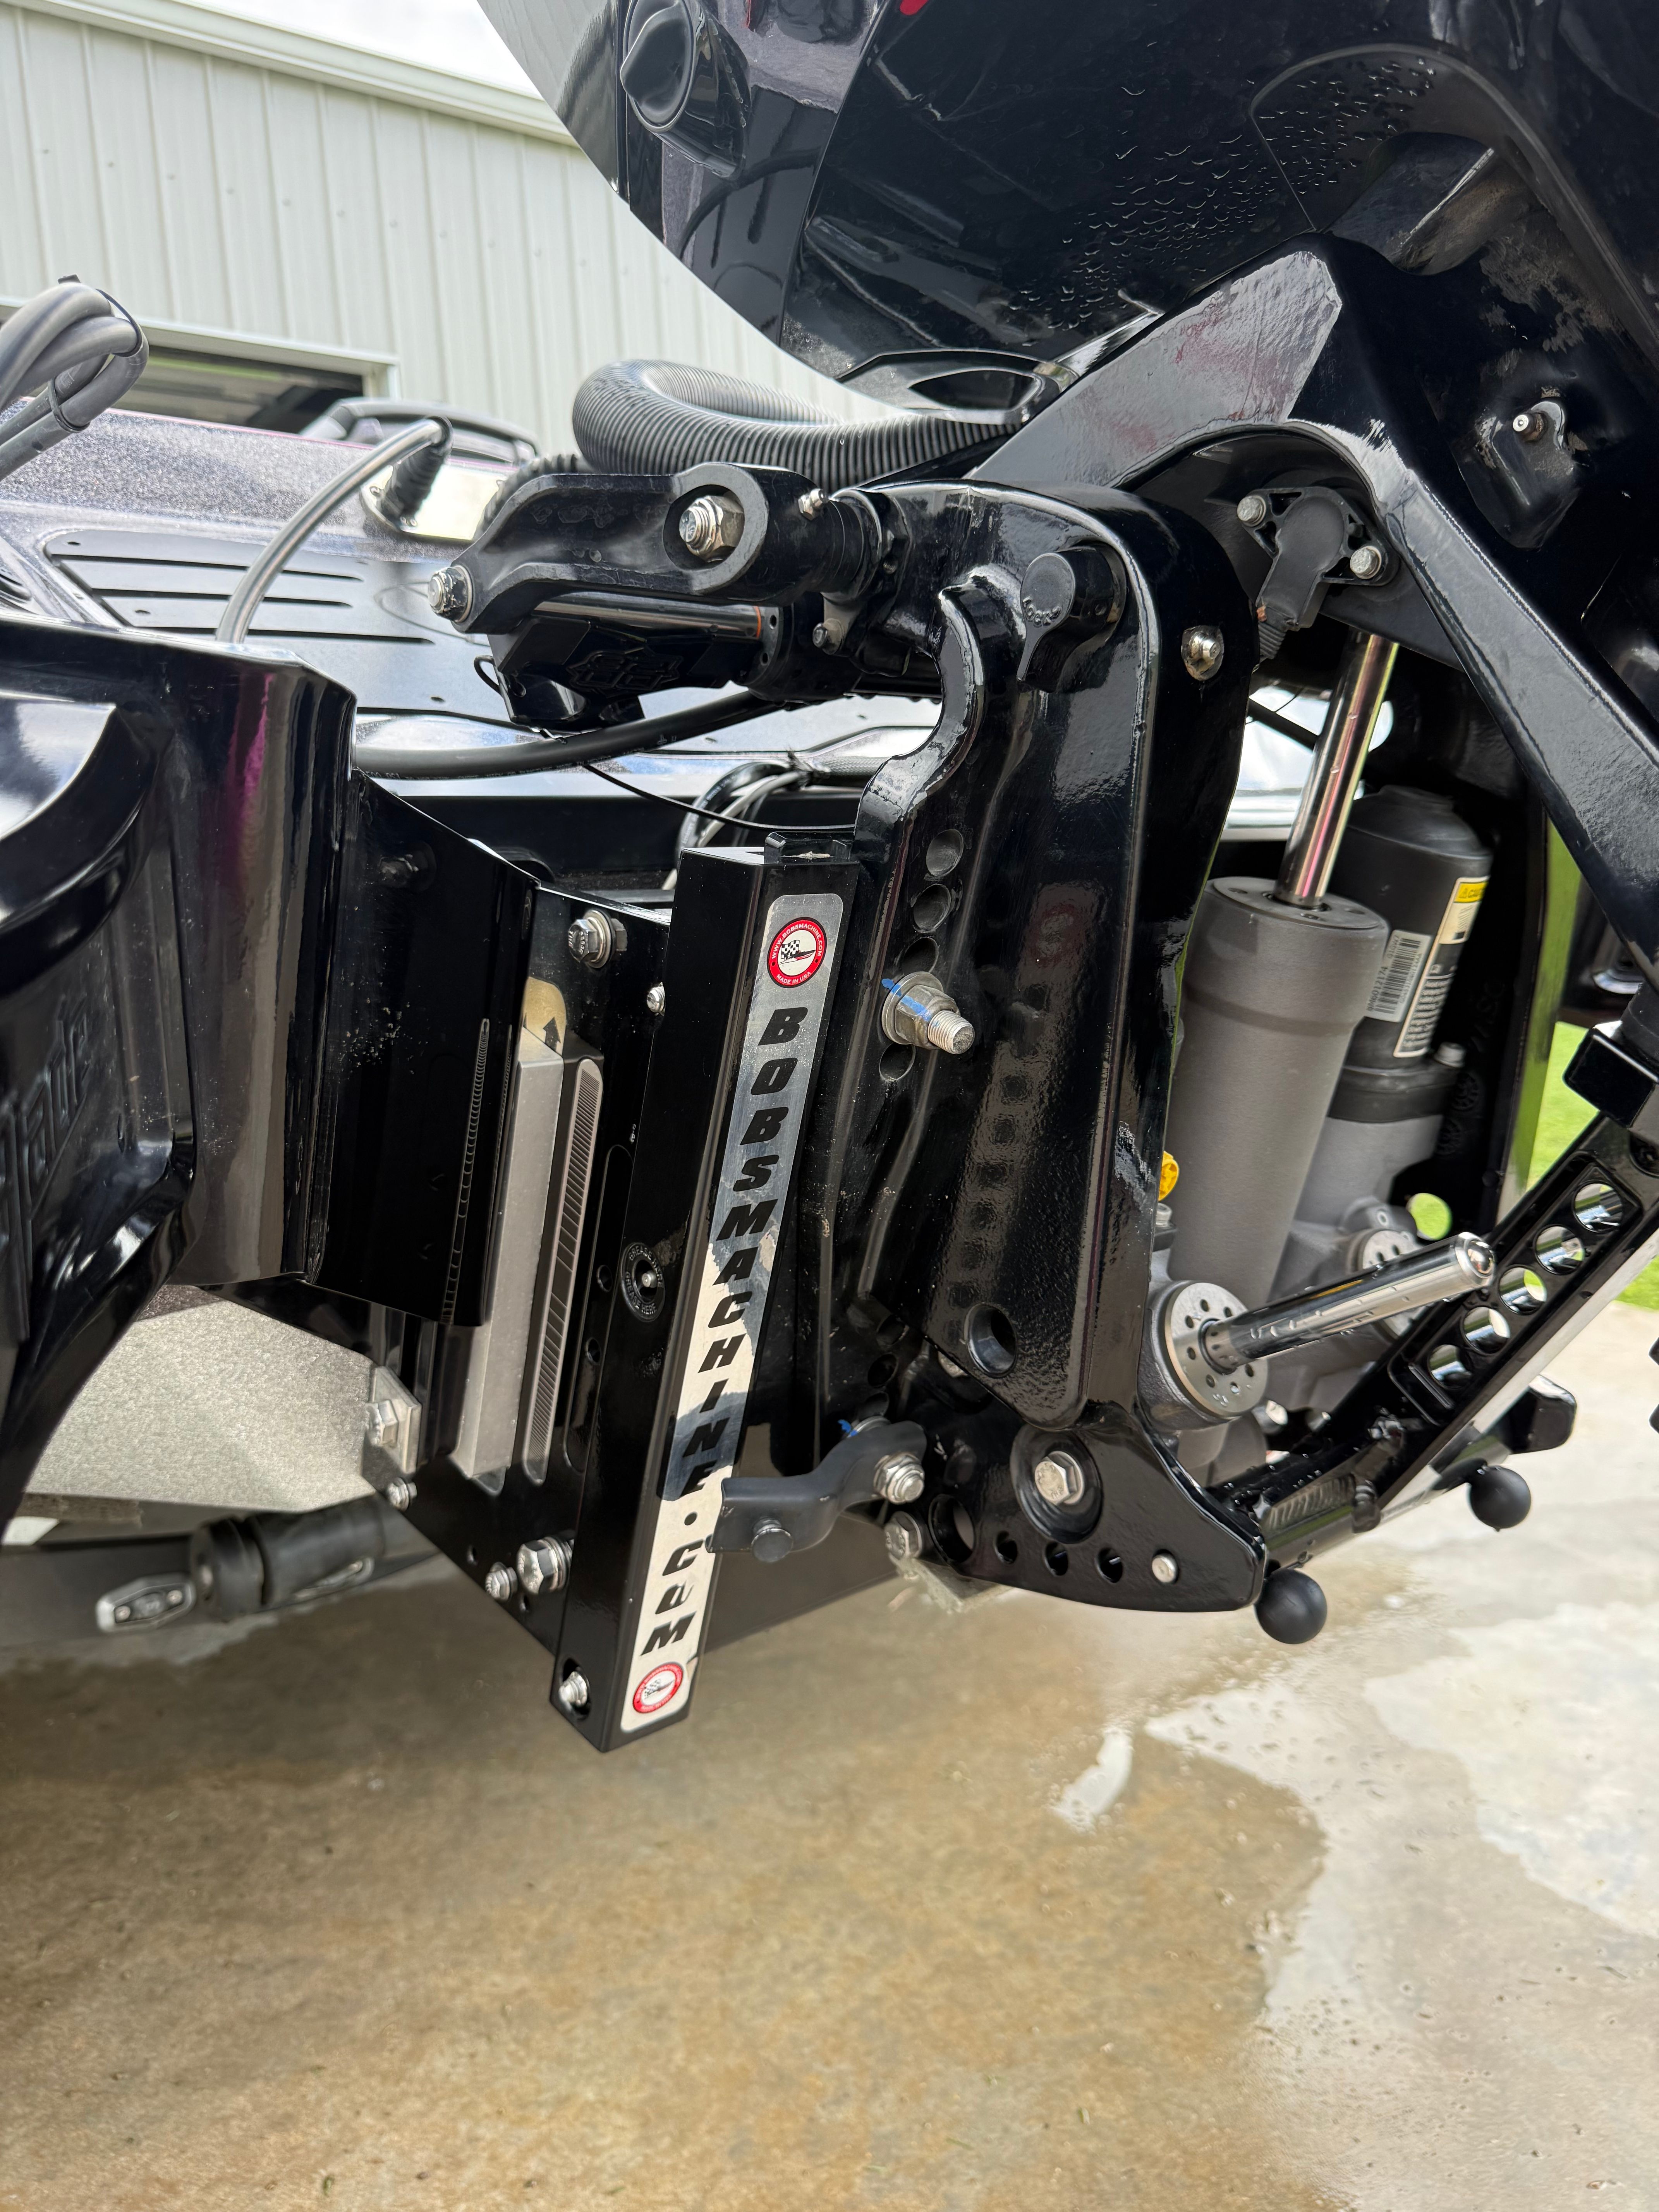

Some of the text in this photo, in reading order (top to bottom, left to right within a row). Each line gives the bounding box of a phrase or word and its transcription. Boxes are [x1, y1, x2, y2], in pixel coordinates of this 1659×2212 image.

[771, 923, 823, 959] WWW.BOBSMACHINE.COM
[776, 974, 792, 984] MADE
[799, 971, 812, 982] USA
[629, 1245, 663, 1288] GREASE HERE
[625, 1271, 657, 1314] GREASE HERE
[641, 1007, 808, 1656] BOBSMACHINE.COM
